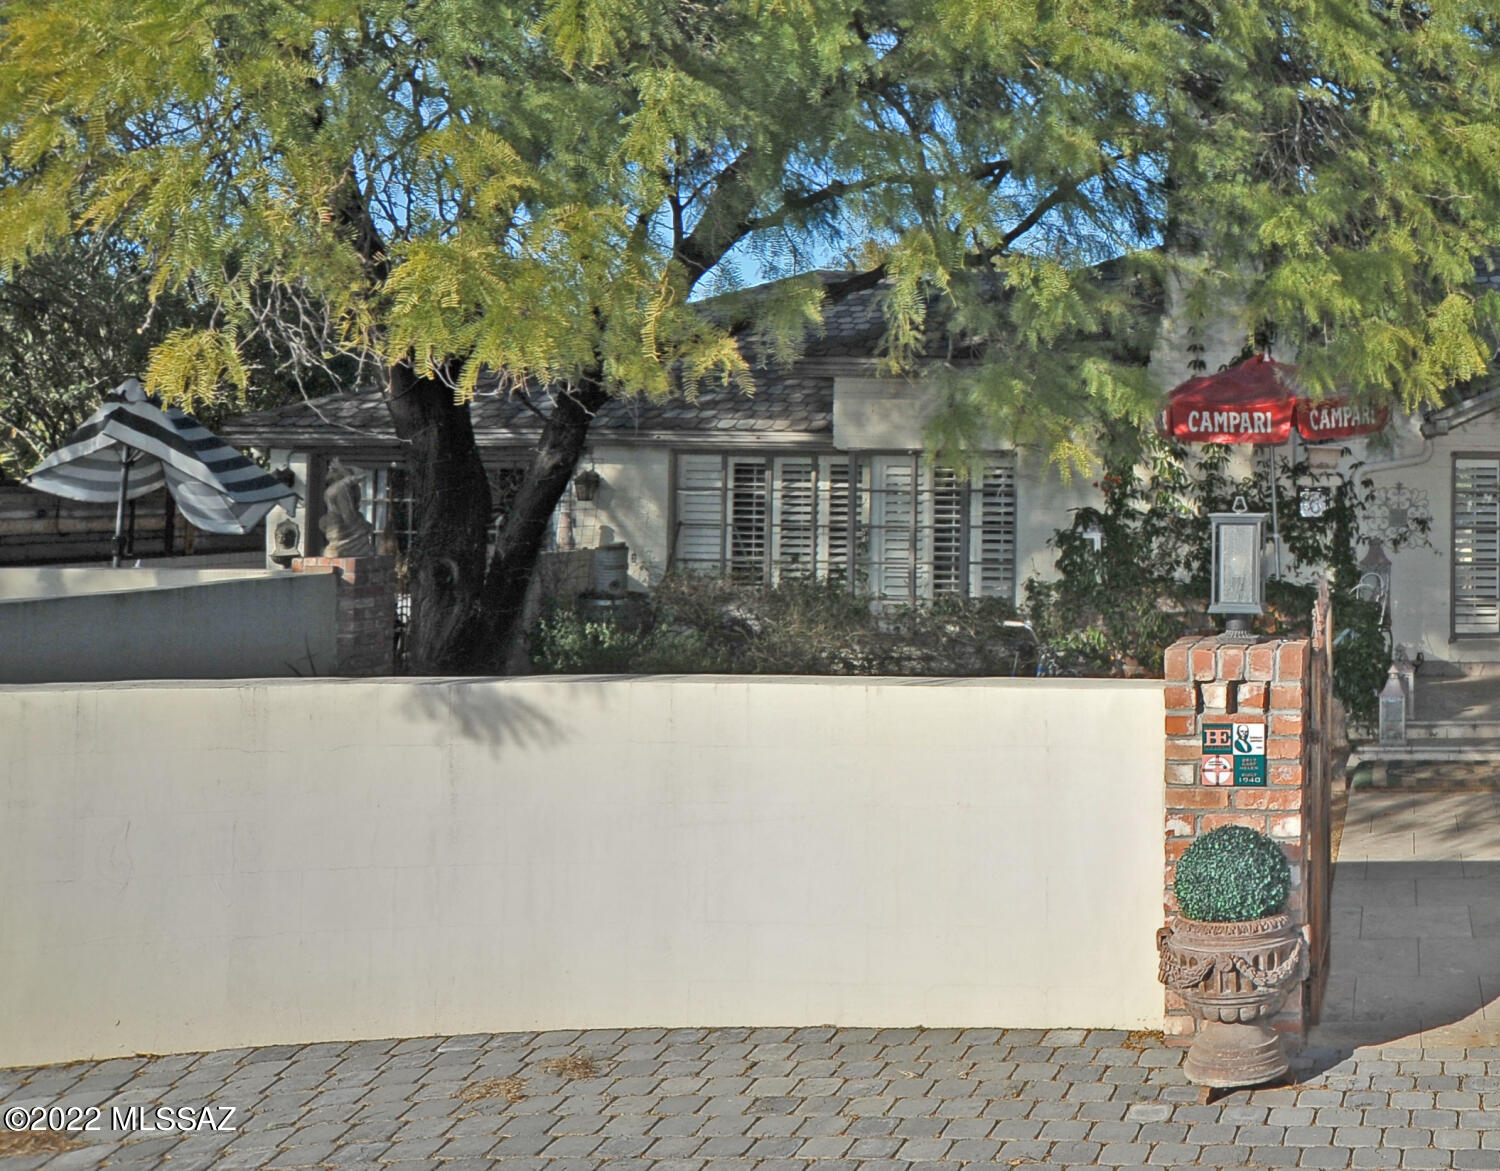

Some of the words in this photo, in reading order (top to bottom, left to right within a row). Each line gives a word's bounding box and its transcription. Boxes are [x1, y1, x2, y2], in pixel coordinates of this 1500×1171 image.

[1188, 411, 1272, 433] CAMPARI
[1310, 406, 1376, 431] CAMPARI
[1204, 729, 1231, 746] BE
